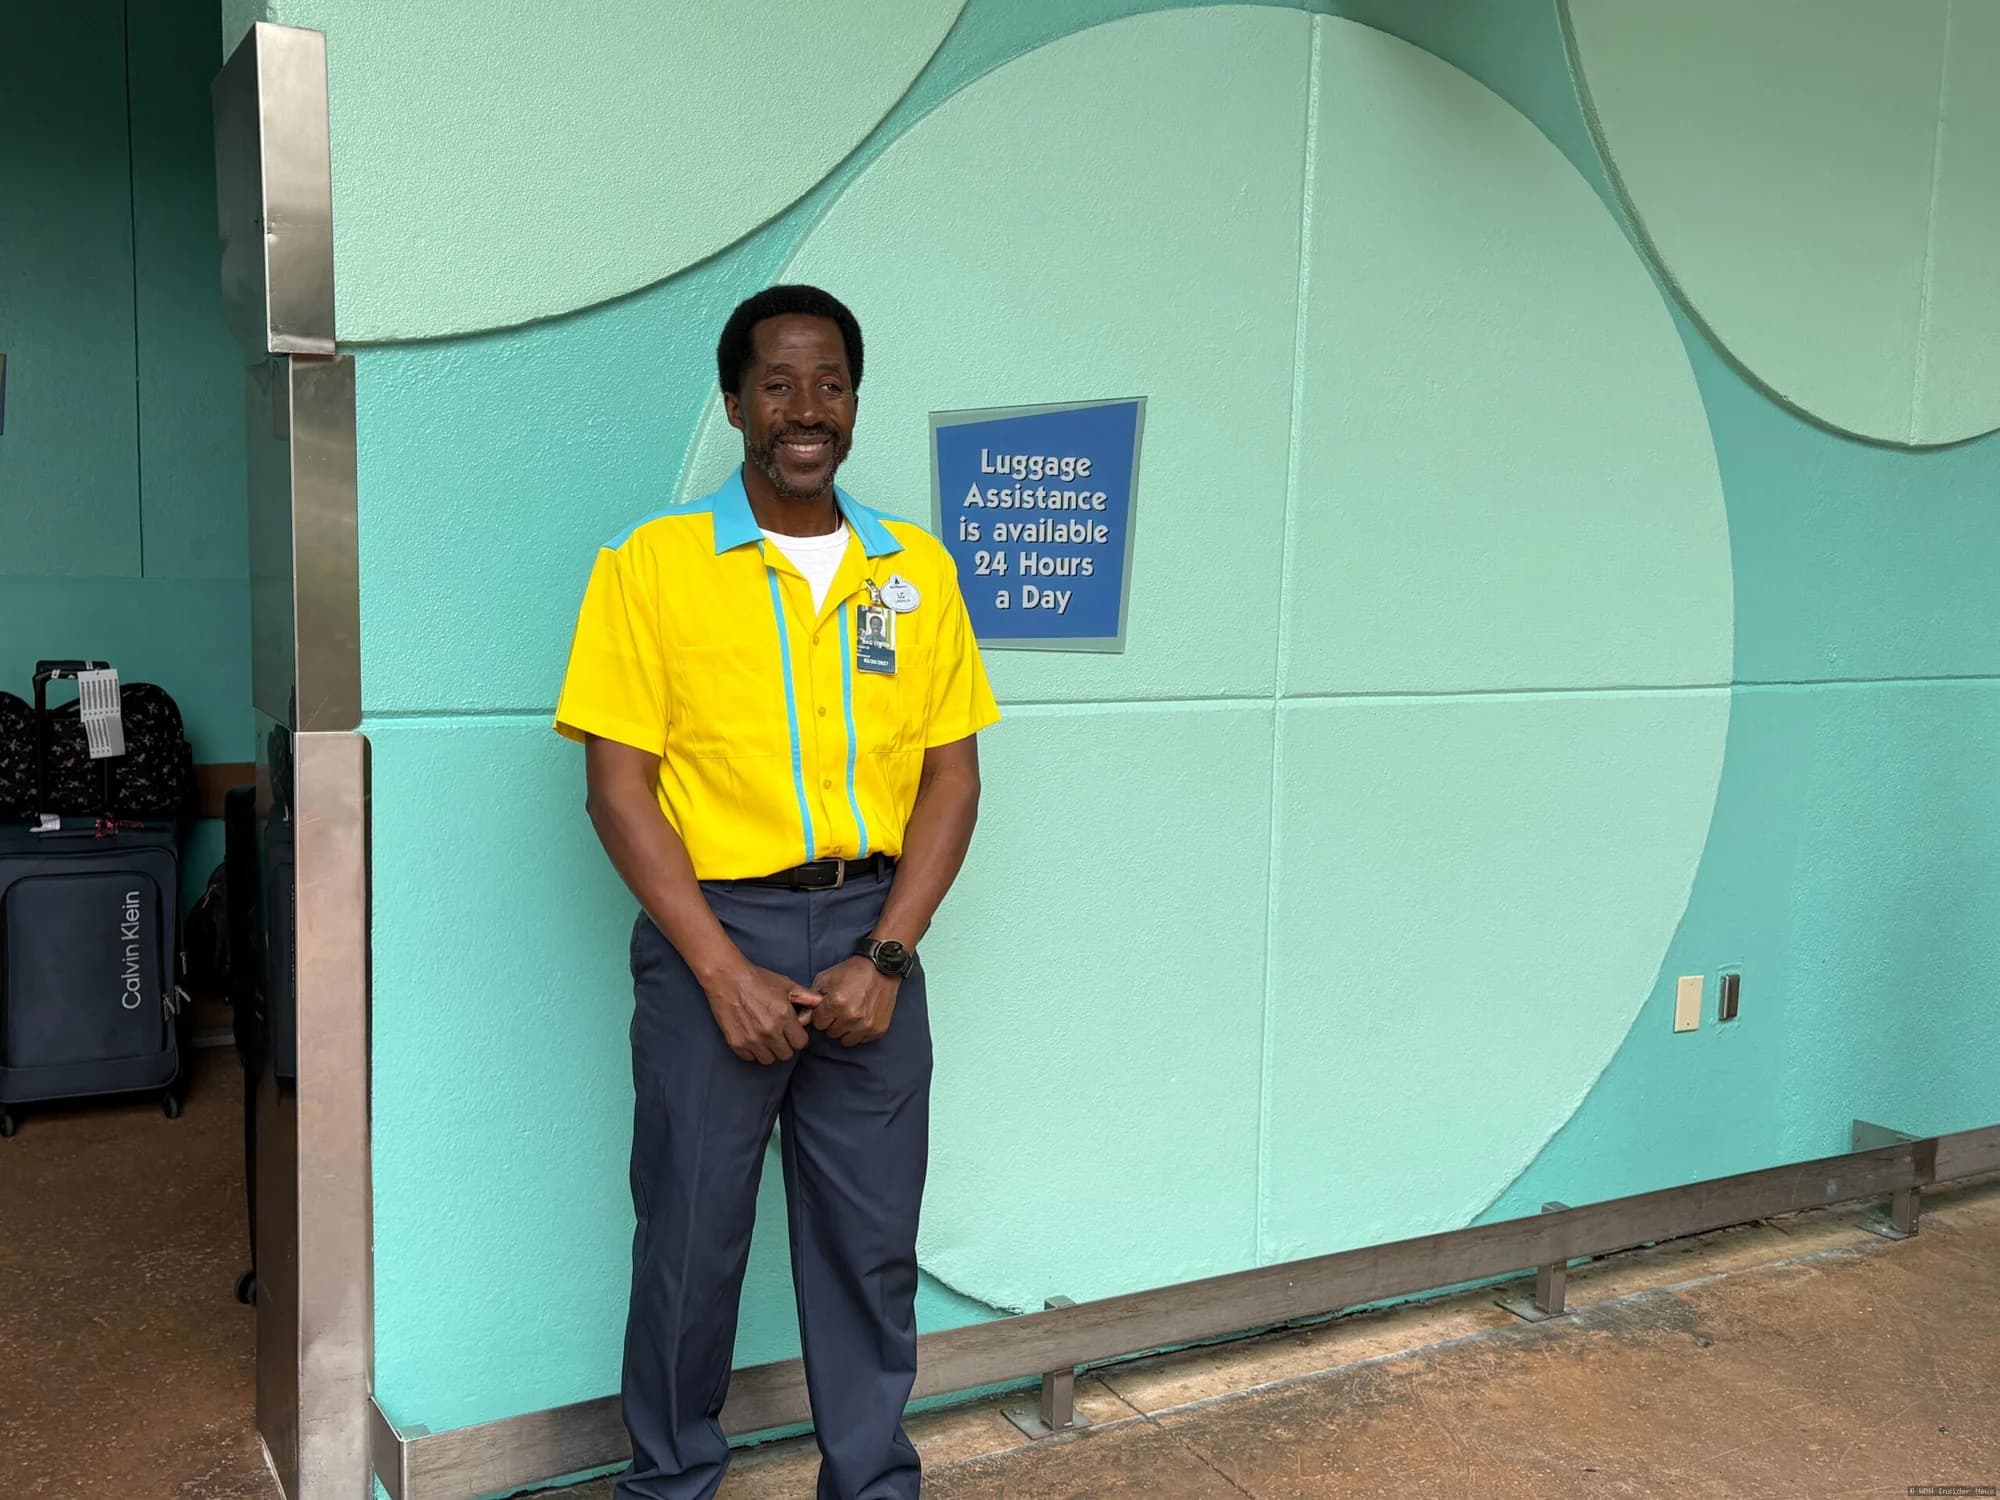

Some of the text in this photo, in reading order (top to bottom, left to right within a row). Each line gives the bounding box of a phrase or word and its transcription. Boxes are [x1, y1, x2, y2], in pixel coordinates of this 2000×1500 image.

[981, 448, 1092, 482] Luggage
[963, 481, 1108, 511] Assistance
[959, 515, 1109, 543] is available
[975, 550, 1094, 577] 24 Hours
[995, 584, 1072, 614] a Day
[120, 891, 141, 1009] Calvin Klein
